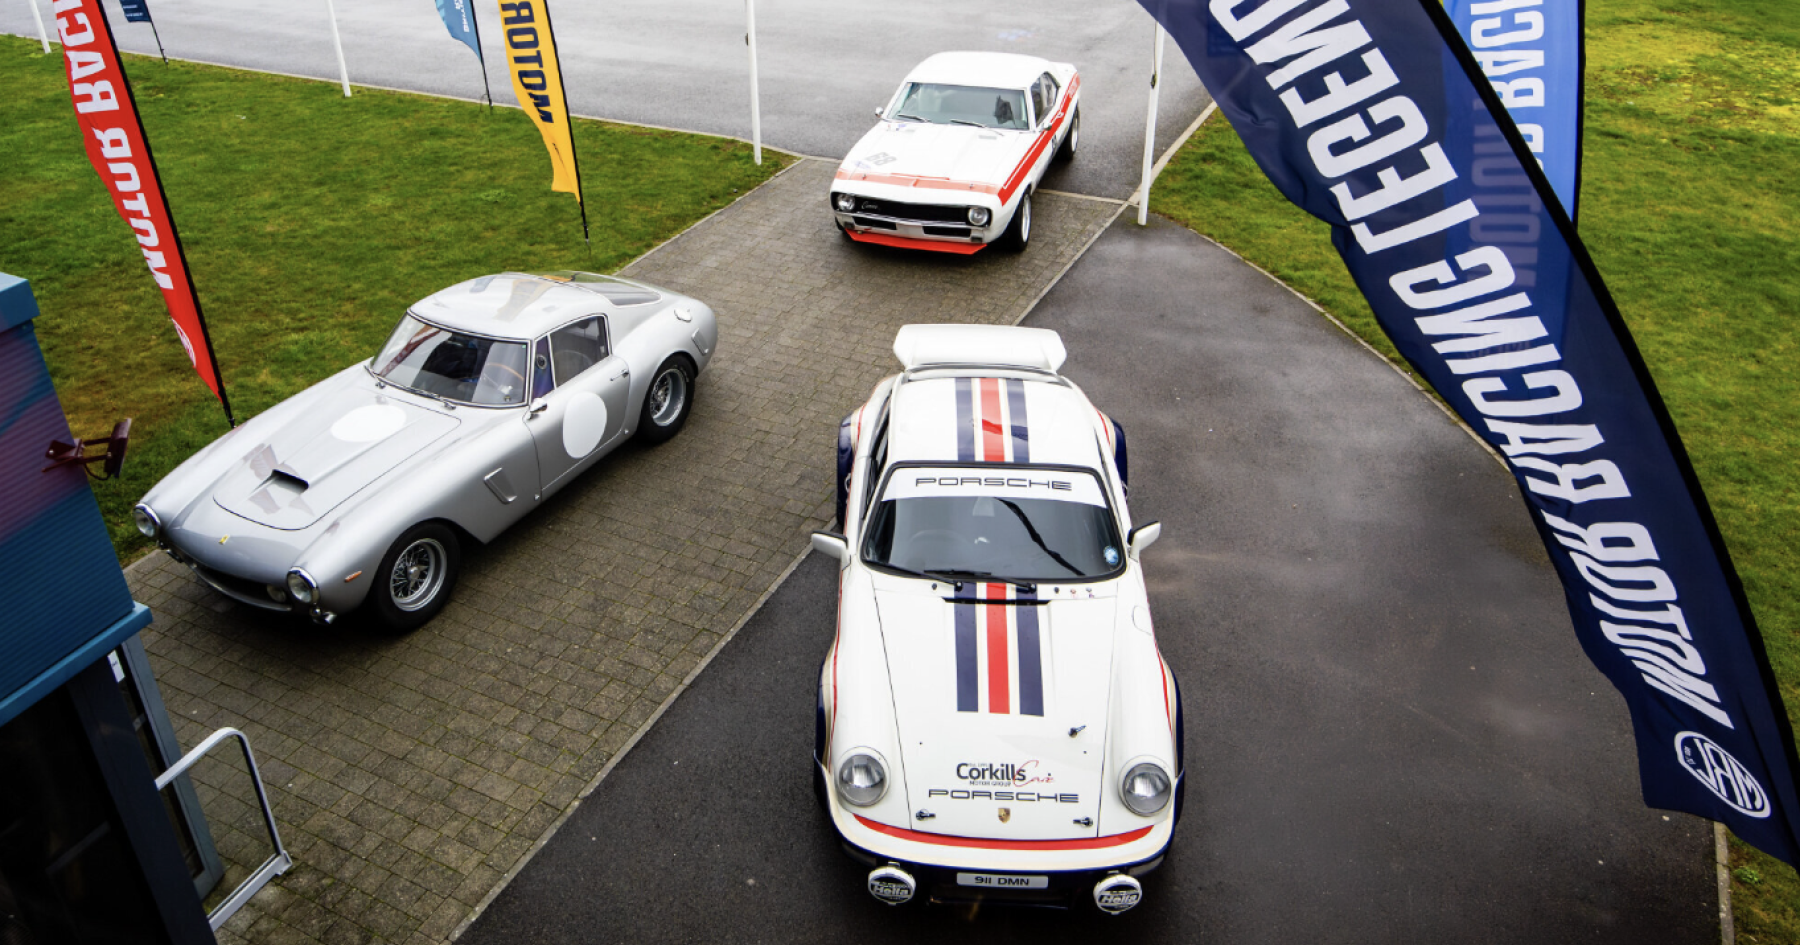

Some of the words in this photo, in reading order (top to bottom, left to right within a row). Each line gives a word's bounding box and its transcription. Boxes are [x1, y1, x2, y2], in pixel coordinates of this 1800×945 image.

[915, 477, 1073, 491] PORSCHE
[956, 762, 1026, 782] Corkills
[928, 788, 1079, 803] PORSCHE
[974, 876, 992, 884] 911
[997, 877, 1030, 886] DMN
[874, 885, 909, 896] Hella
[1100, 894, 1138, 904] Hella
